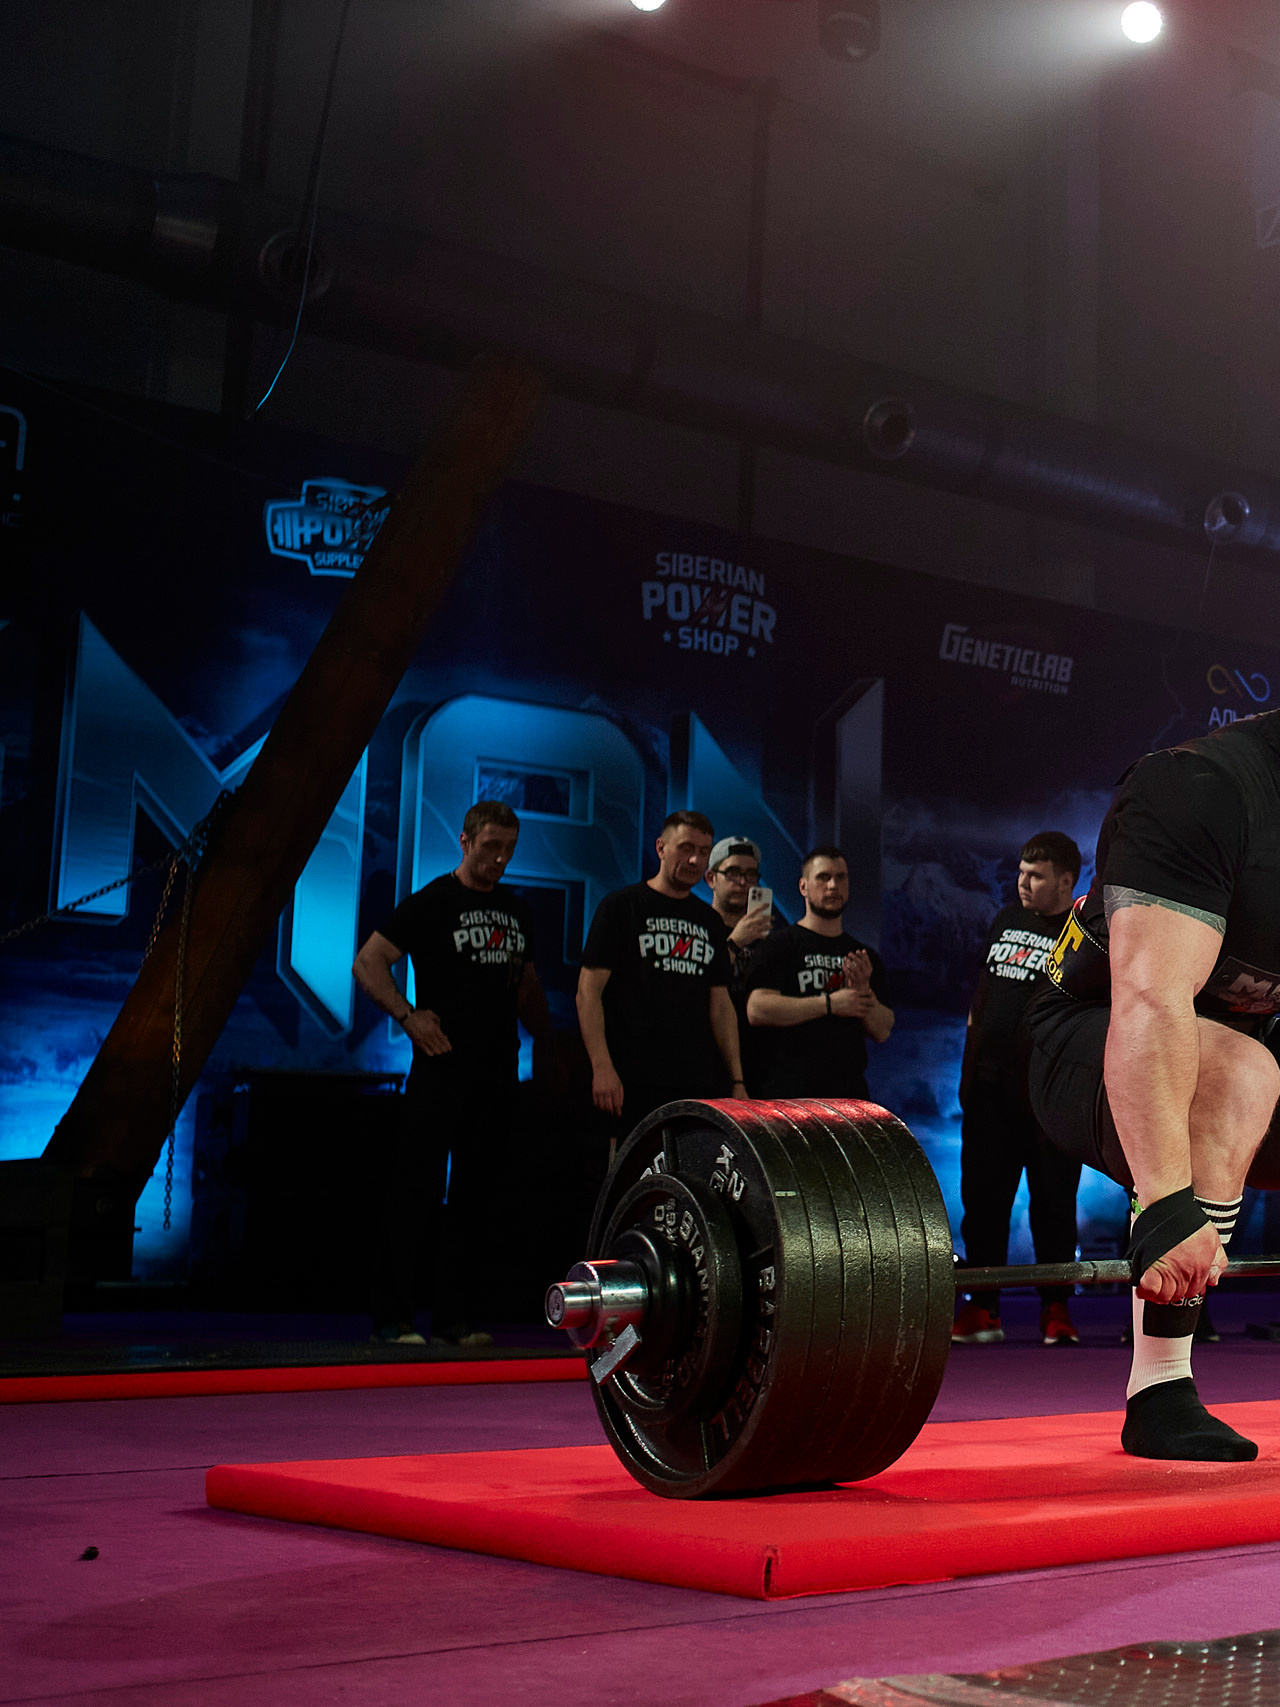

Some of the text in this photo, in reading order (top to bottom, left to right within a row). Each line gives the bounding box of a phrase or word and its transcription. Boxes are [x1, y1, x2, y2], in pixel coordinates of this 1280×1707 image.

[314, 552, 364, 569] SUPPLE
[656, 552, 766, 597] SIBERIAN
[641, 581, 777, 644] POWER
[678, 626, 740, 656] SHOP
[645, 916, 710, 941] SIBERIAN
[999, 928, 1058, 951] SIBERIAN
[638, 932, 716, 966] POWER
[662, 957, 698, 976] SHOW
[995, 963, 1030, 981] SHOW
